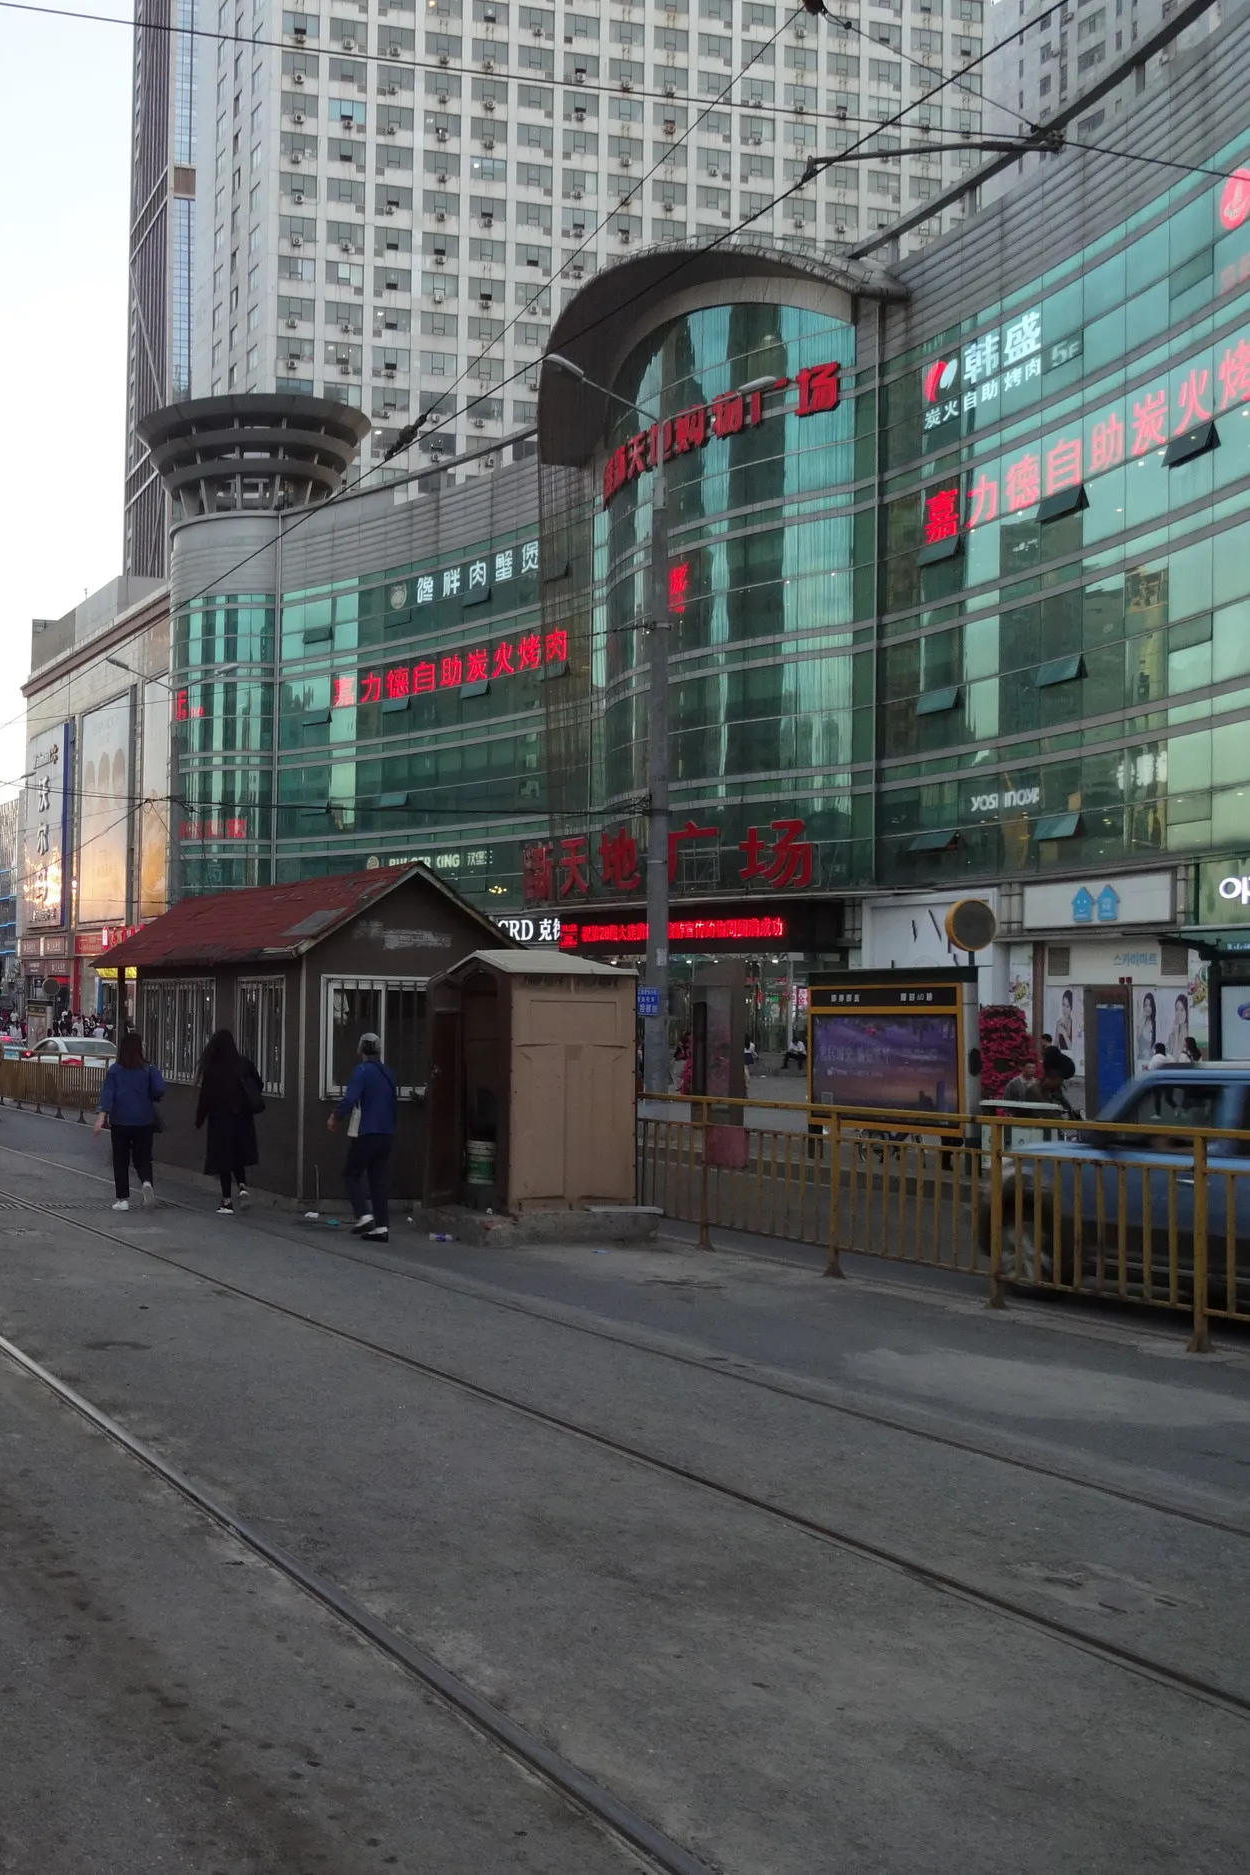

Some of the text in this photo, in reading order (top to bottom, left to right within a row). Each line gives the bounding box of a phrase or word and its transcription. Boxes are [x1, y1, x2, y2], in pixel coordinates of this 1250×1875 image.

[964, 311, 1042, 384] 韩盛
[924, 357, 1042, 430] 炭火自助烤肉
[416, 540, 540, 605] 馋胖肉蟹煲
[332, 627, 568, 709] 嘉力德自助炭火烤肉
[522, 819, 814, 898] 新天地广场
